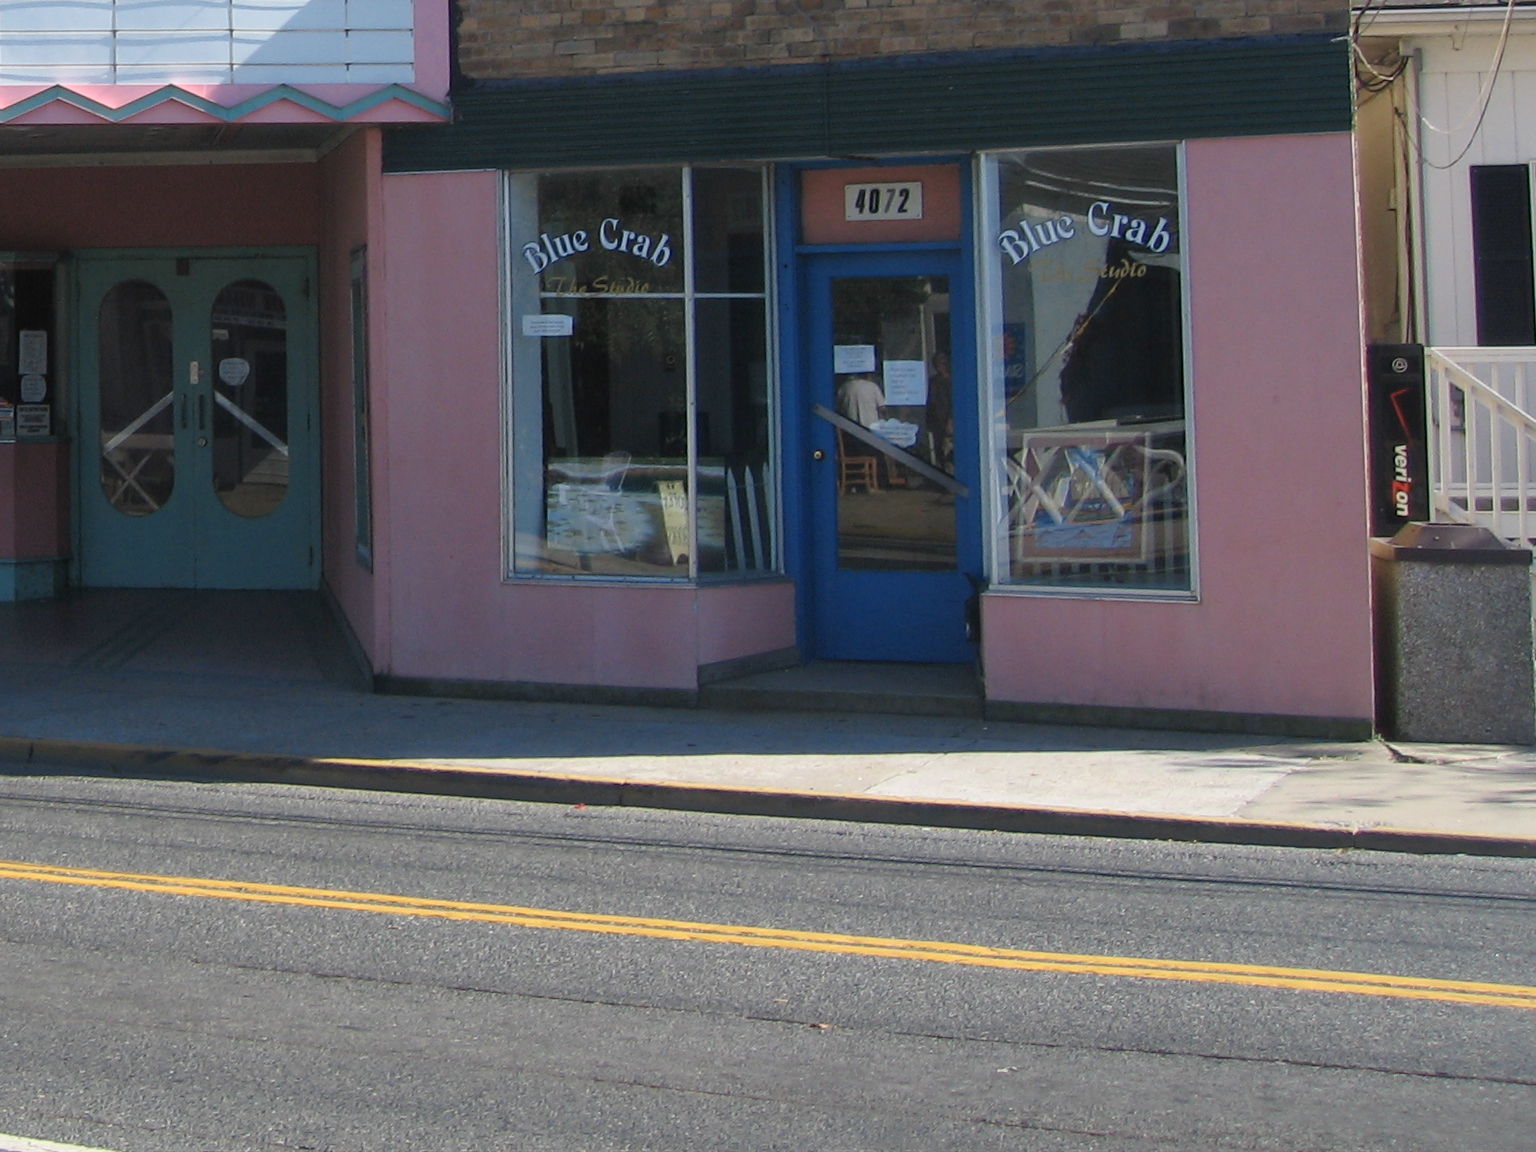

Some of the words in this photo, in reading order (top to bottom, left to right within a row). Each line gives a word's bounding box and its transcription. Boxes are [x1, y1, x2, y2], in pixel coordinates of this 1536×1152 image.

[855, 188, 910, 214] 4072
[522, 229, 589, 274] Blue
[599, 217, 671, 267] Crab
[999, 216, 1075, 265] Blue
[1087, 201, 1171, 253] Crab
[586, 275, 651, 298] Studio
[1392, 444, 1412, 517] verizon
